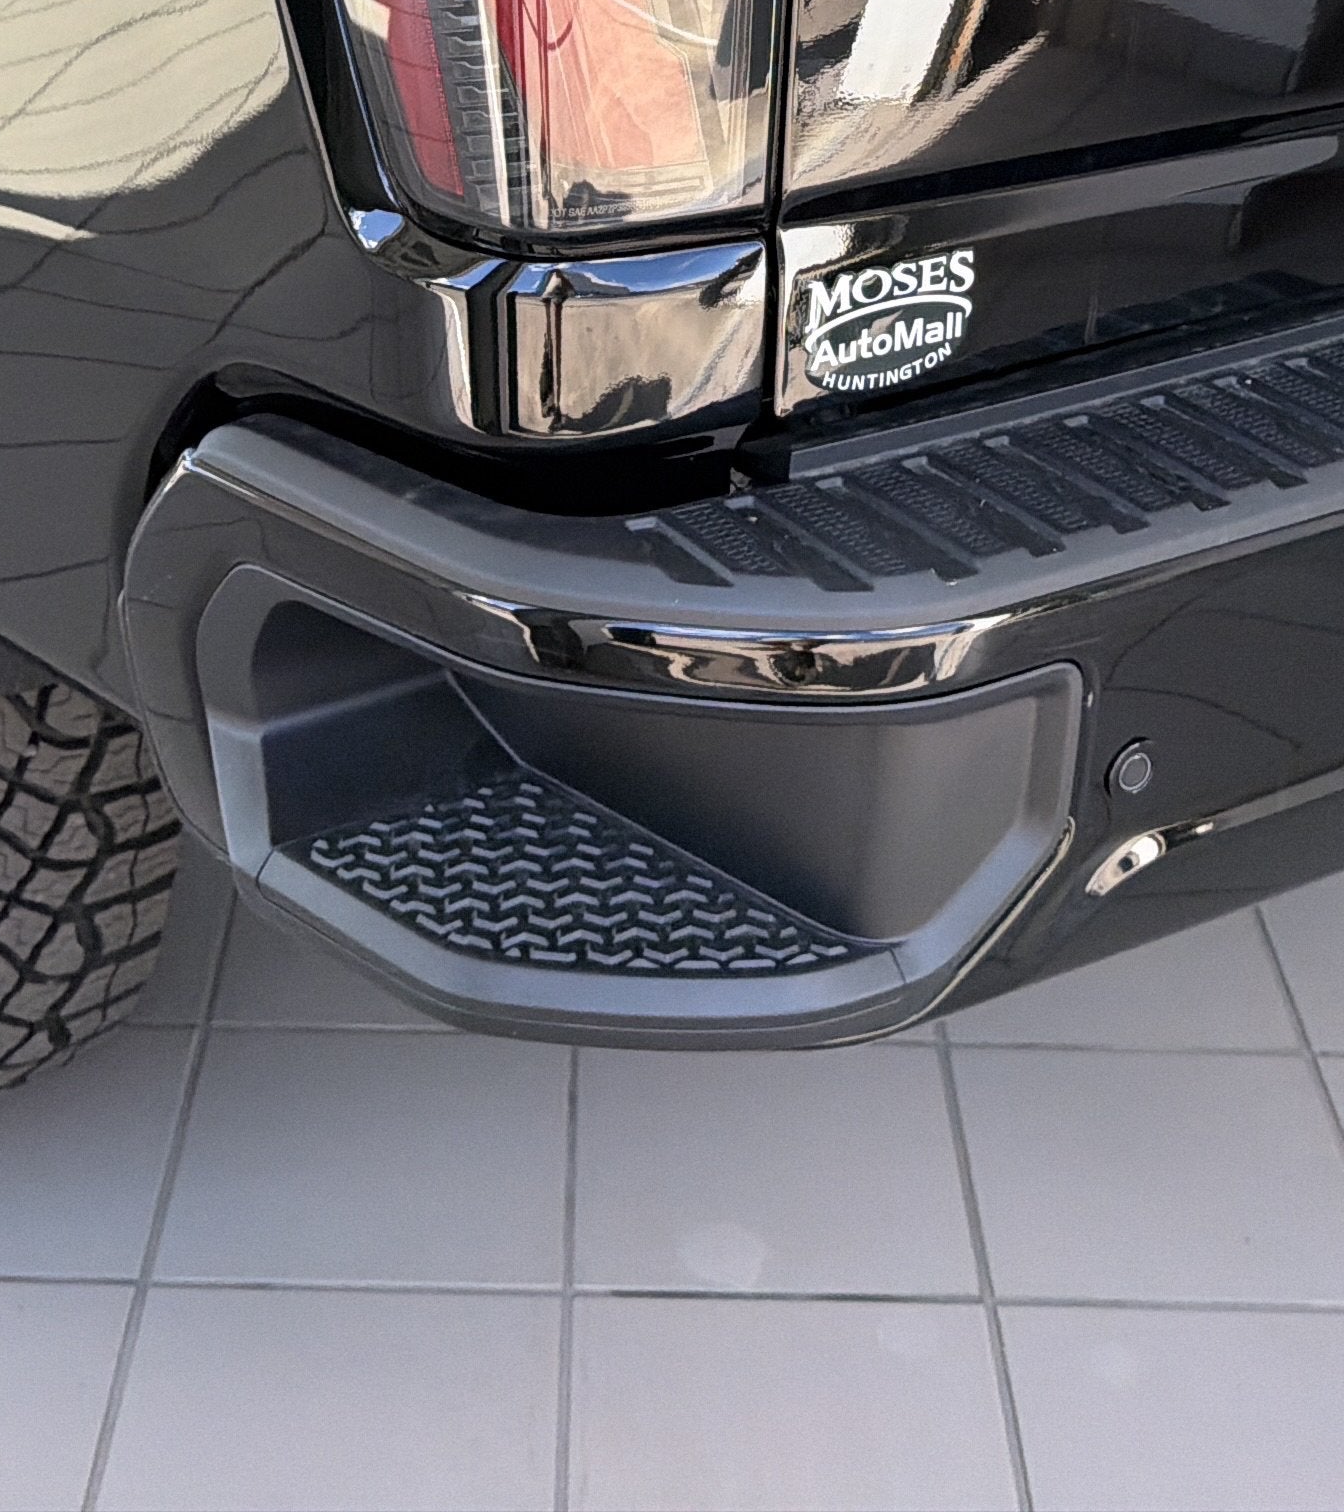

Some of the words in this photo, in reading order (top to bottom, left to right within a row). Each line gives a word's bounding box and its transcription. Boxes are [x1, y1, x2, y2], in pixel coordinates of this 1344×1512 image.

[805, 249, 975, 334] MOSES
[810, 311, 963, 372] AutoMall
[821, 341, 952, 391] HUNTINGTON
